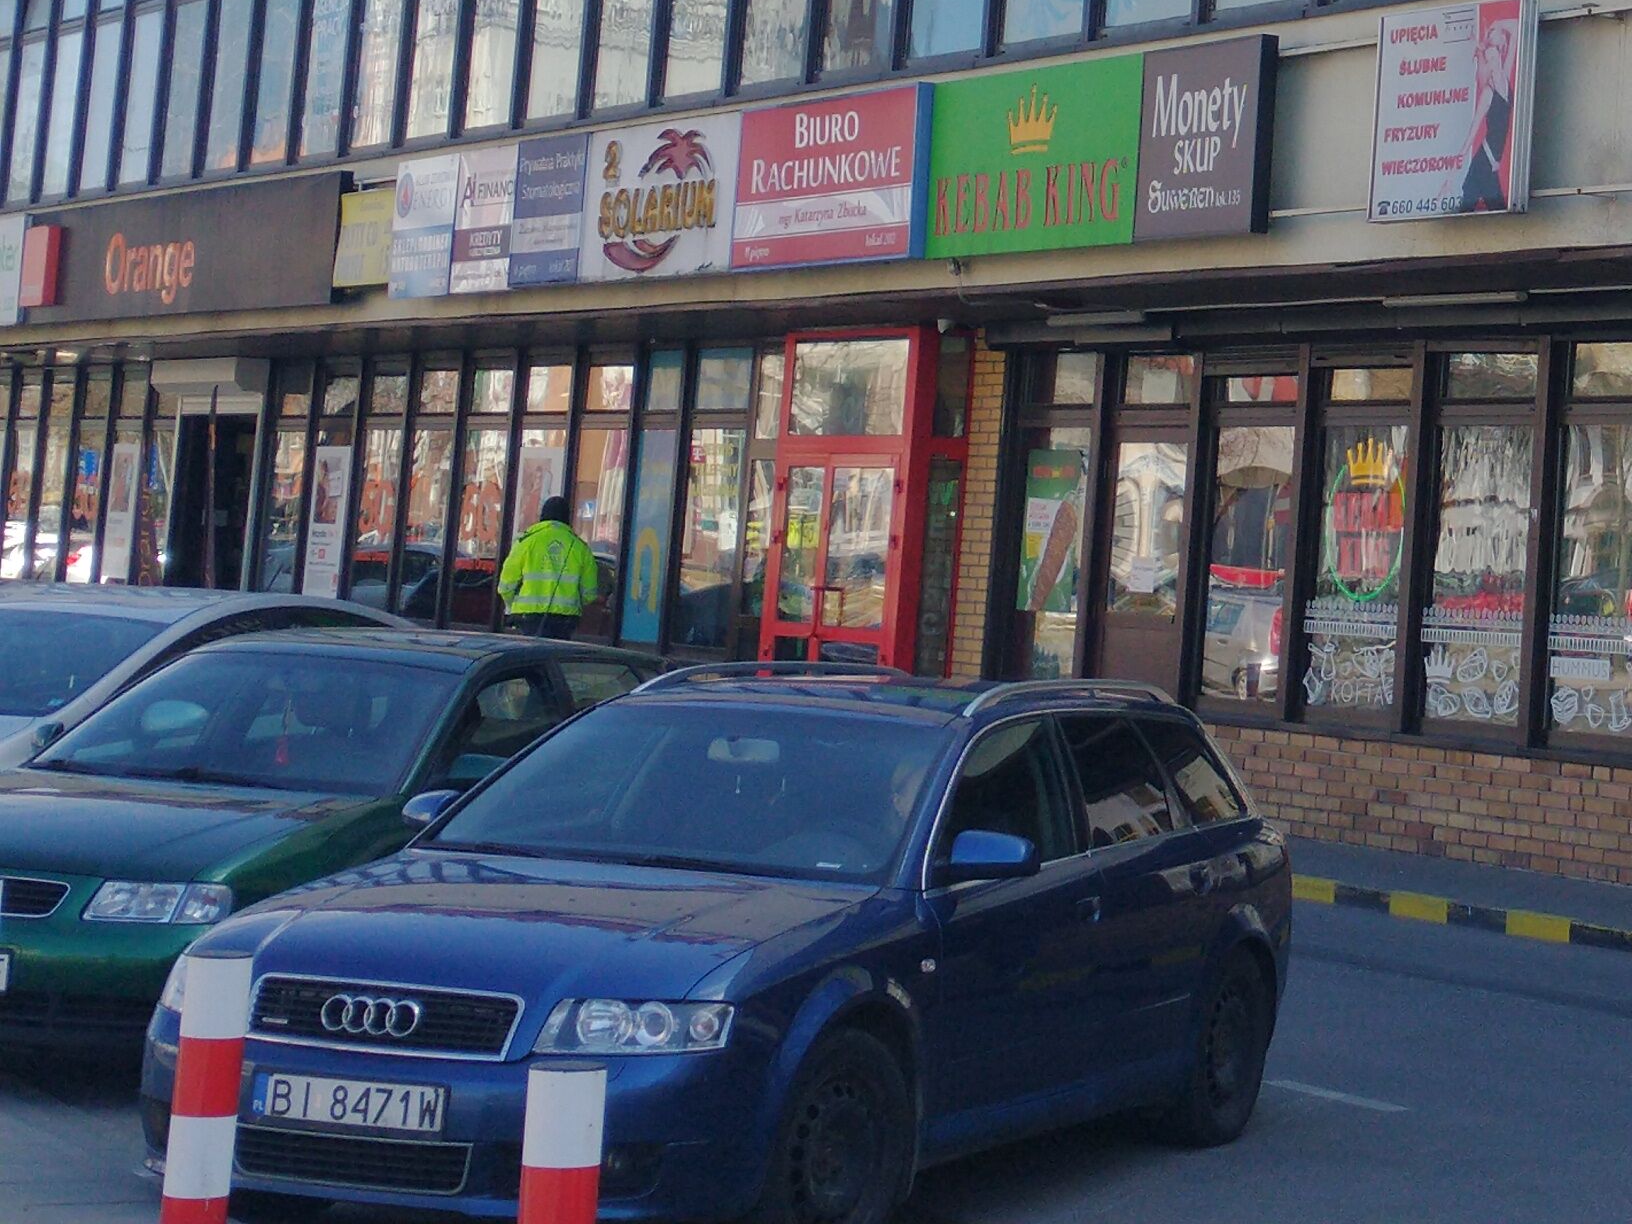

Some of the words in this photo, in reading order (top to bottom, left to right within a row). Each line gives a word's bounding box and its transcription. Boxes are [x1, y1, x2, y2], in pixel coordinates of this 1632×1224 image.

[1390, 24, 1439, 45] UPIĘCIA
[1399, 56, 1447, 76] ŚLUBNE
[1397, 87, 1470, 109] KOMUNIJNE
[1152, 74, 1248, 149] Monety
[1384, 123, 1441, 143] FRYZURY
[1174, 136, 1221, 175] SKUP
[1381, 154, 1464, 176] WIECZOROWE
[933, 168, 1032, 236] KEBAB
[1043, 158, 1120, 226] KING
[1391, 199, 1412, 215] 660
[598, 178, 716, 240] SOLARIUM
[105, 232, 195, 304] Orange
[1552, 660, 1609, 677] HUMMUS
[271, 1078, 311, 1118] BI
[330, 1085, 440, 1128] 8471W
